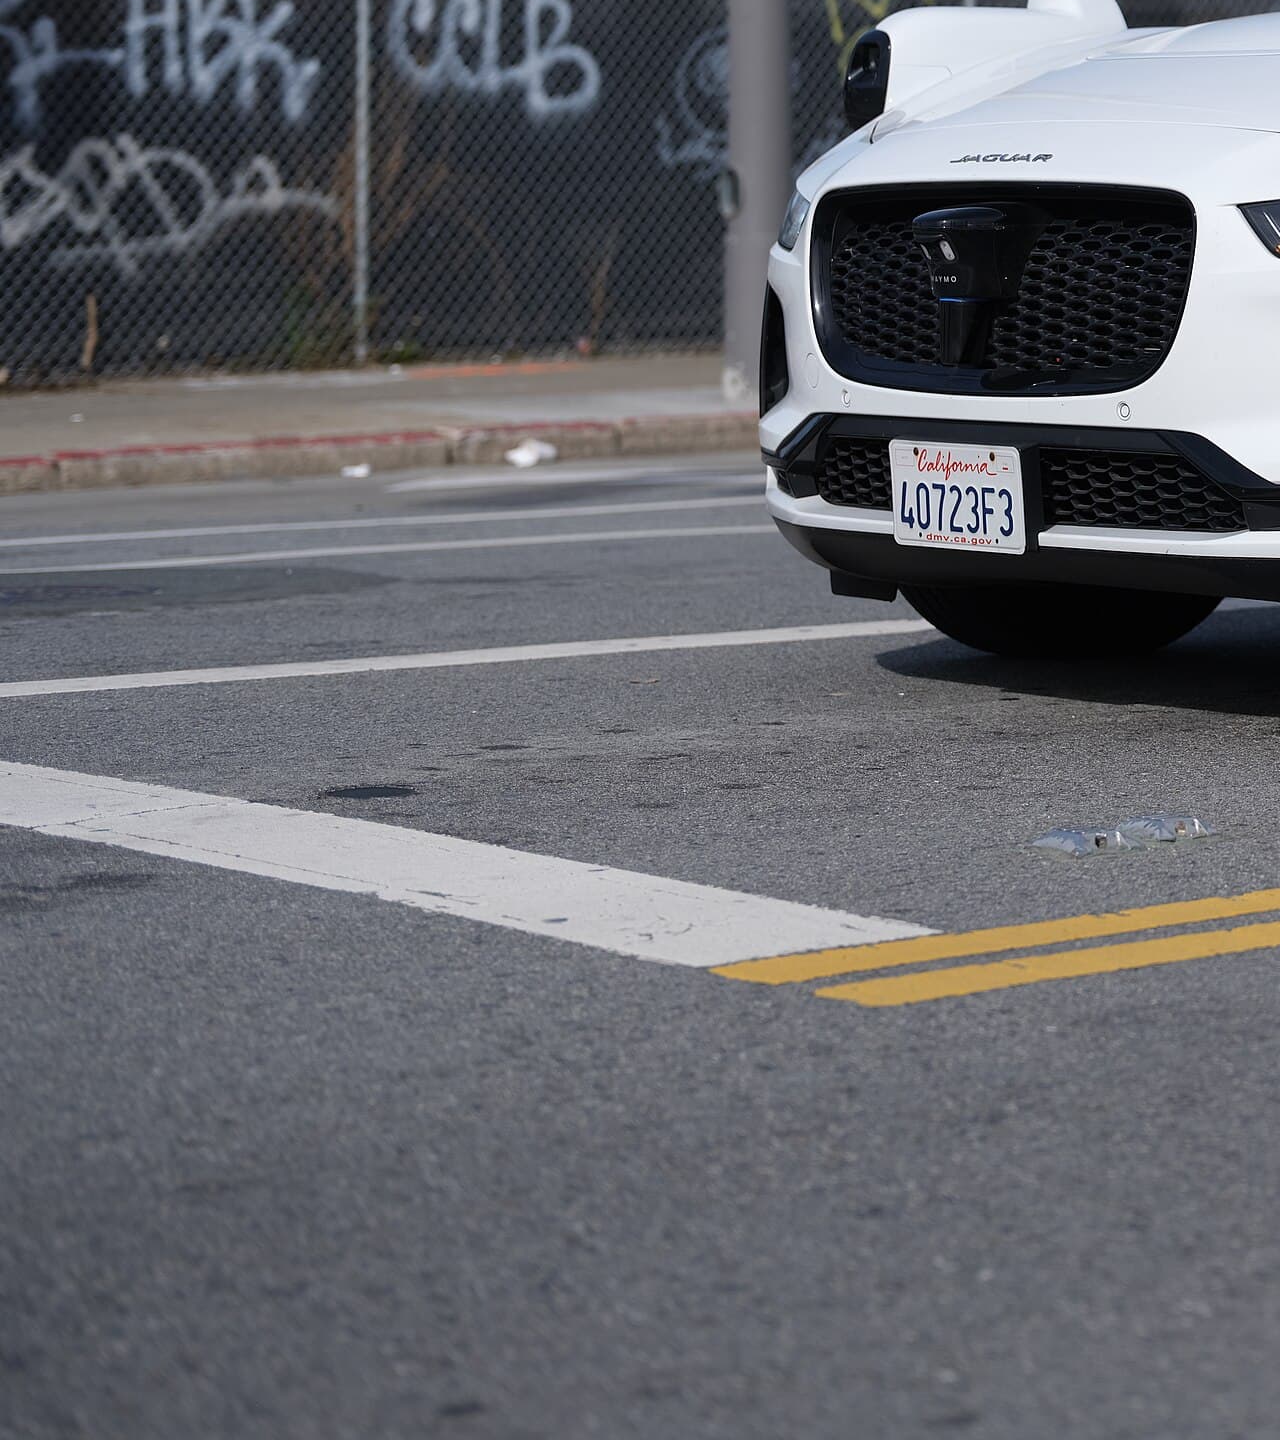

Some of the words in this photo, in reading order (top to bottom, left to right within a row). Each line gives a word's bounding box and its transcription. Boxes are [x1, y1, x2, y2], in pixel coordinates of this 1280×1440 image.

[949, 153, 1054, 164] JAGUAR
[917, 448, 998, 481] California
[900, 480, 1014, 537] 40723F3
[926, 533, 993, 546] dmv.ca.gov
